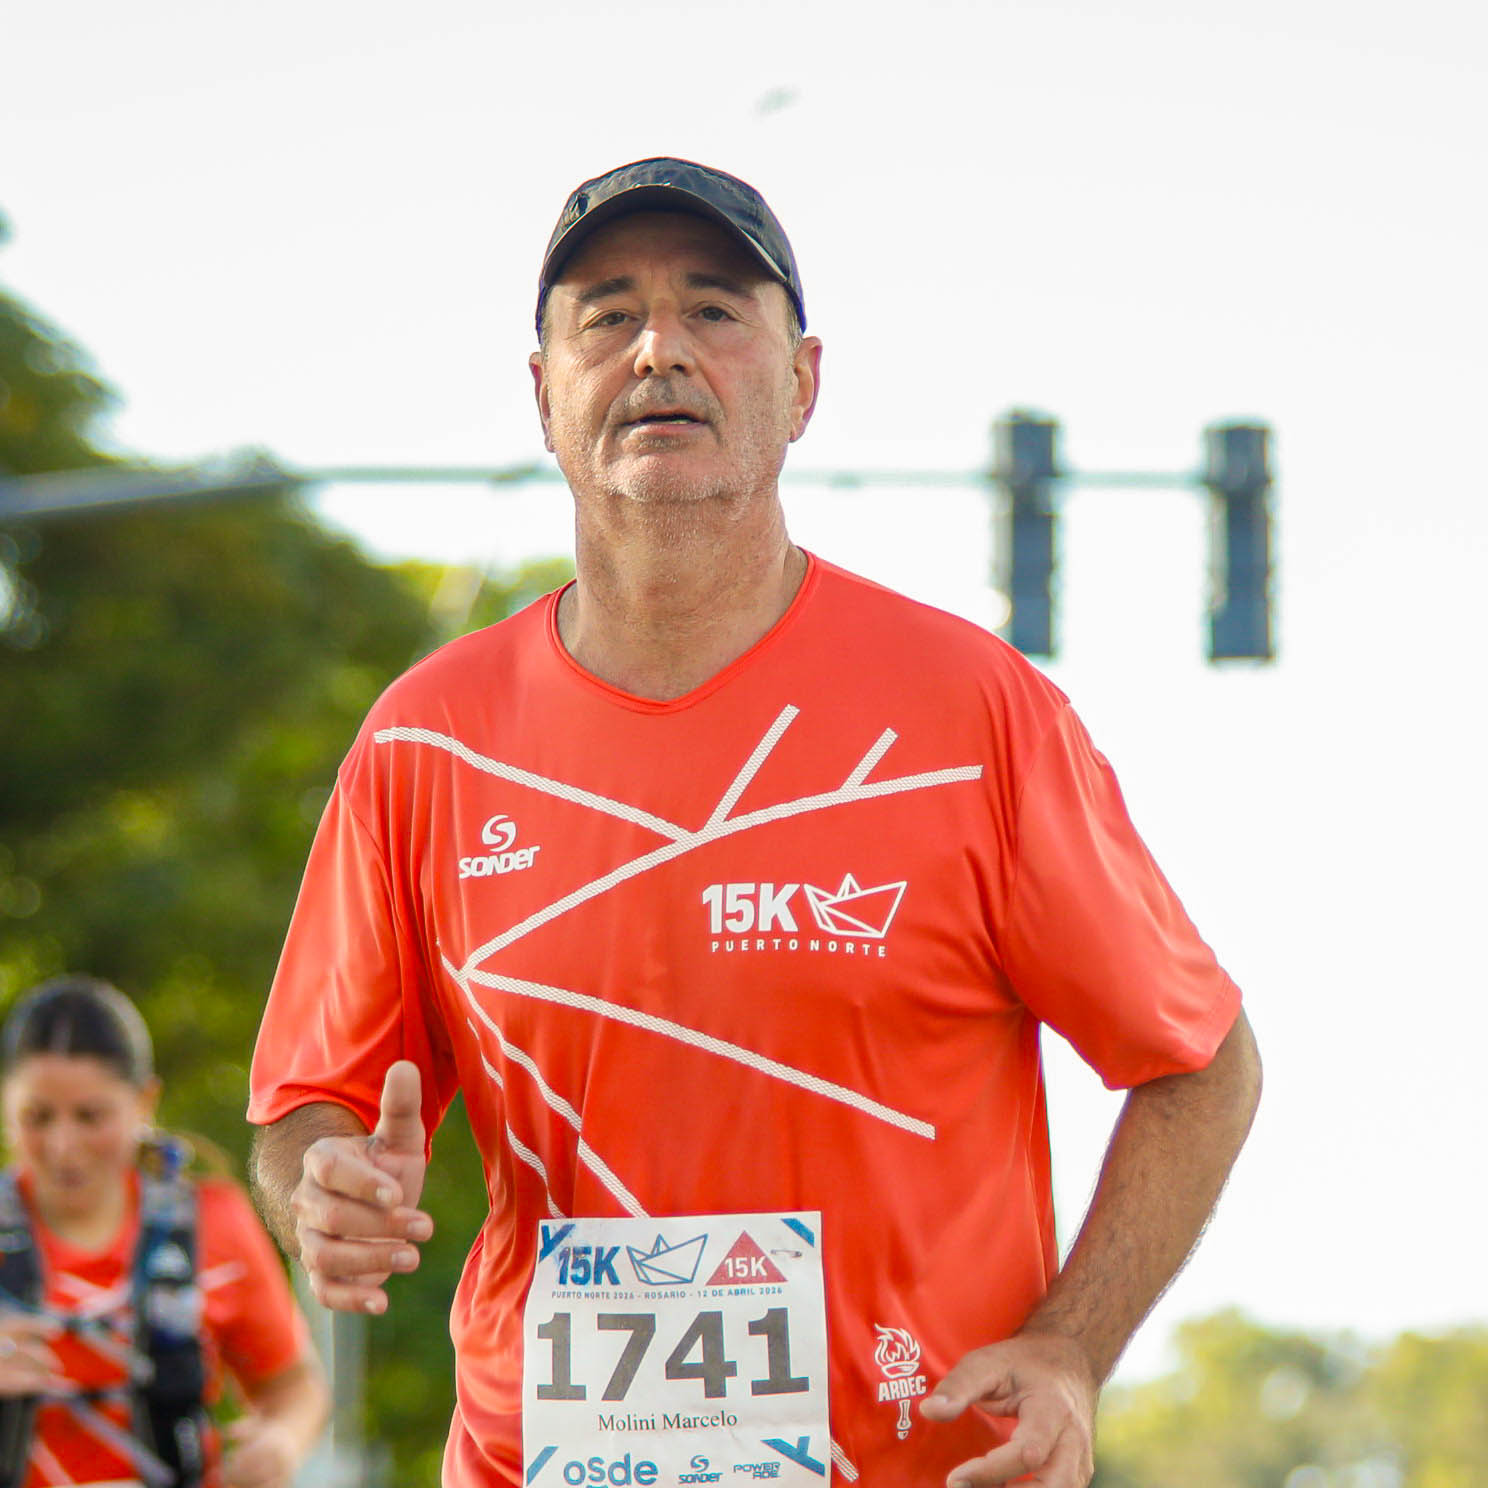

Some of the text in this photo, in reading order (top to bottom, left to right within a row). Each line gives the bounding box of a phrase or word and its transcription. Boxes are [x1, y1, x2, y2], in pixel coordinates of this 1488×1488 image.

[702, 882, 801, 934] 15K
[711, 938, 886, 957] PUERTO NORTE
[558, 1245, 621, 1286] 15K
[724, 1255, 768, 1278] 15K
[552, 1290, 582, 1300] PUERTO
[584, 1291, 611, 1300] NORTE
[644, 1290, 686, 1300] ROSARIO
[697, 1290, 707, 1299] 12
[711, 1288, 723, 1297] DE
[727, 1287, 756, 1297] ABRIL
[760, 1286, 783, 1295] 2026
[537, 1307, 810, 1401] 1741
[878, 1375, 927, 1402] ARDEC
[598, 1410, 738, 1431] Molini Marcelo
[563, 1452, 659, 1488] osde
[733, 1462, 781, 1473] POWER
[752, 1471, 782, 1480] ADE
